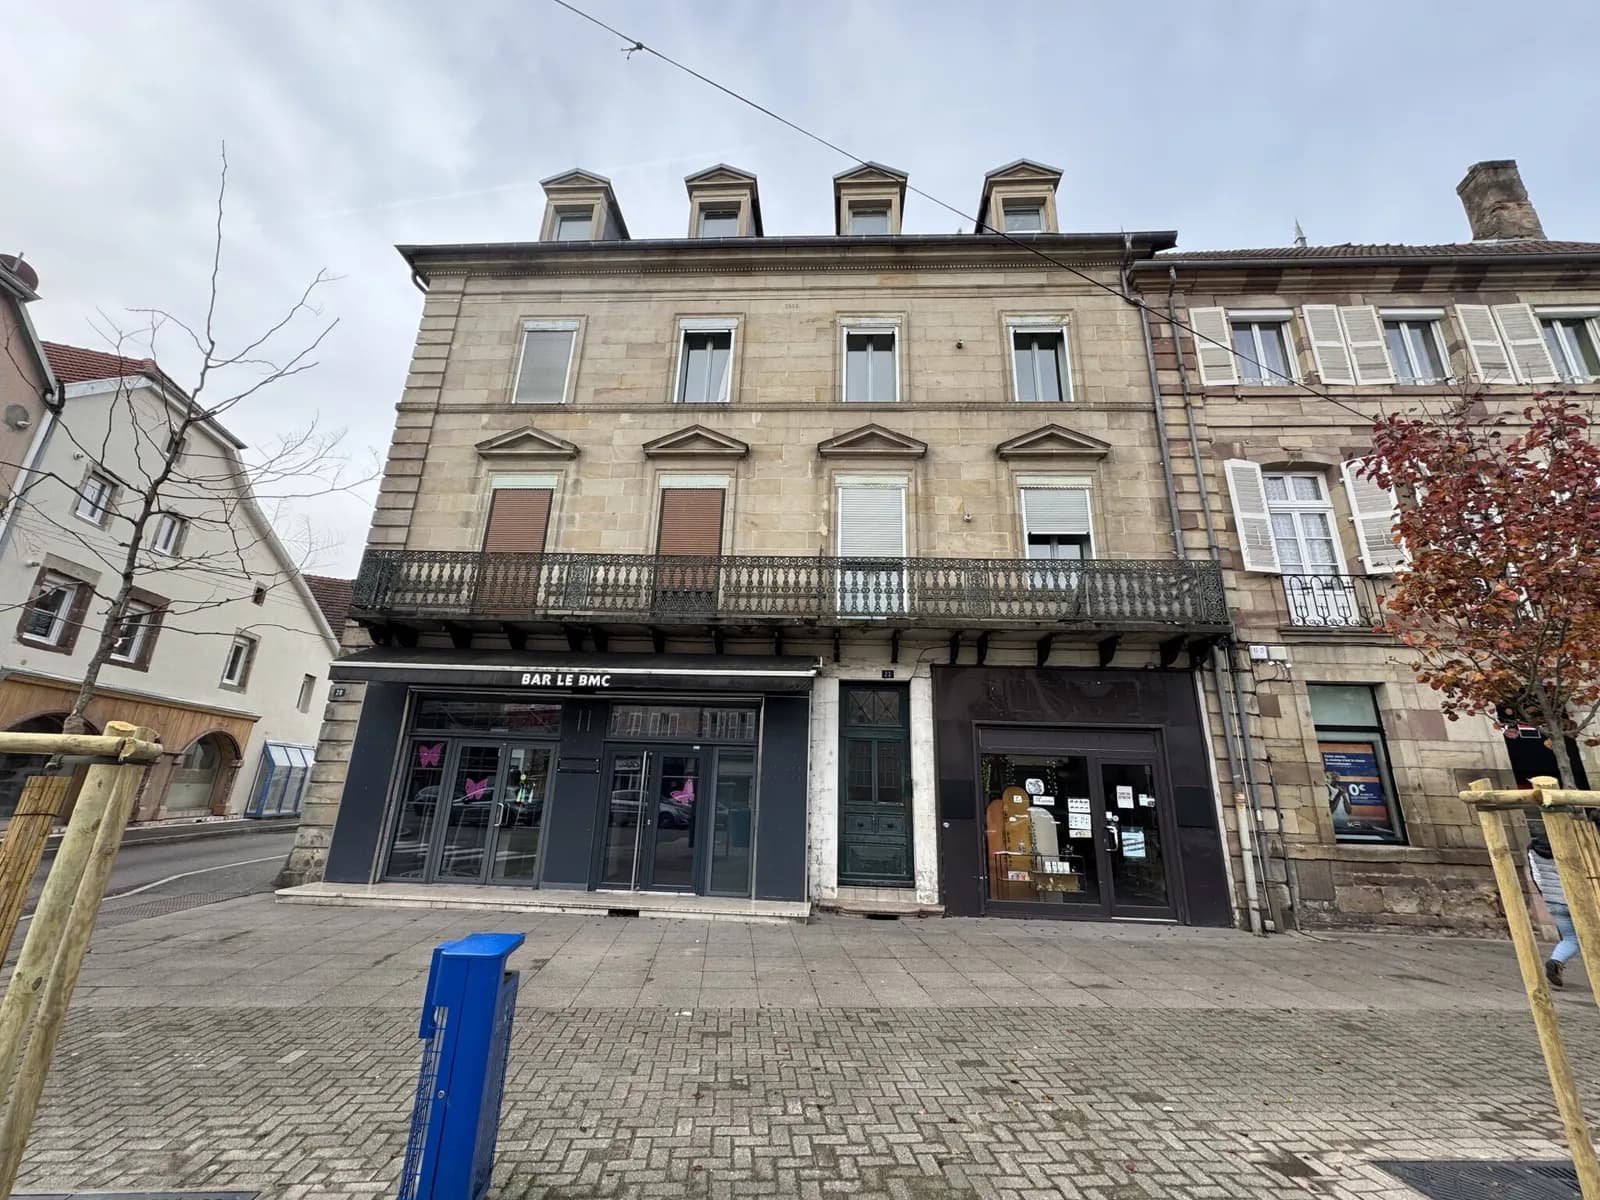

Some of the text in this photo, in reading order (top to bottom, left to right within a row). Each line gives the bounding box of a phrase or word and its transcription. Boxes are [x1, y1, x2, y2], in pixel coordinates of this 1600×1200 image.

[521, 673, 611, 687] BAR LE BMC
